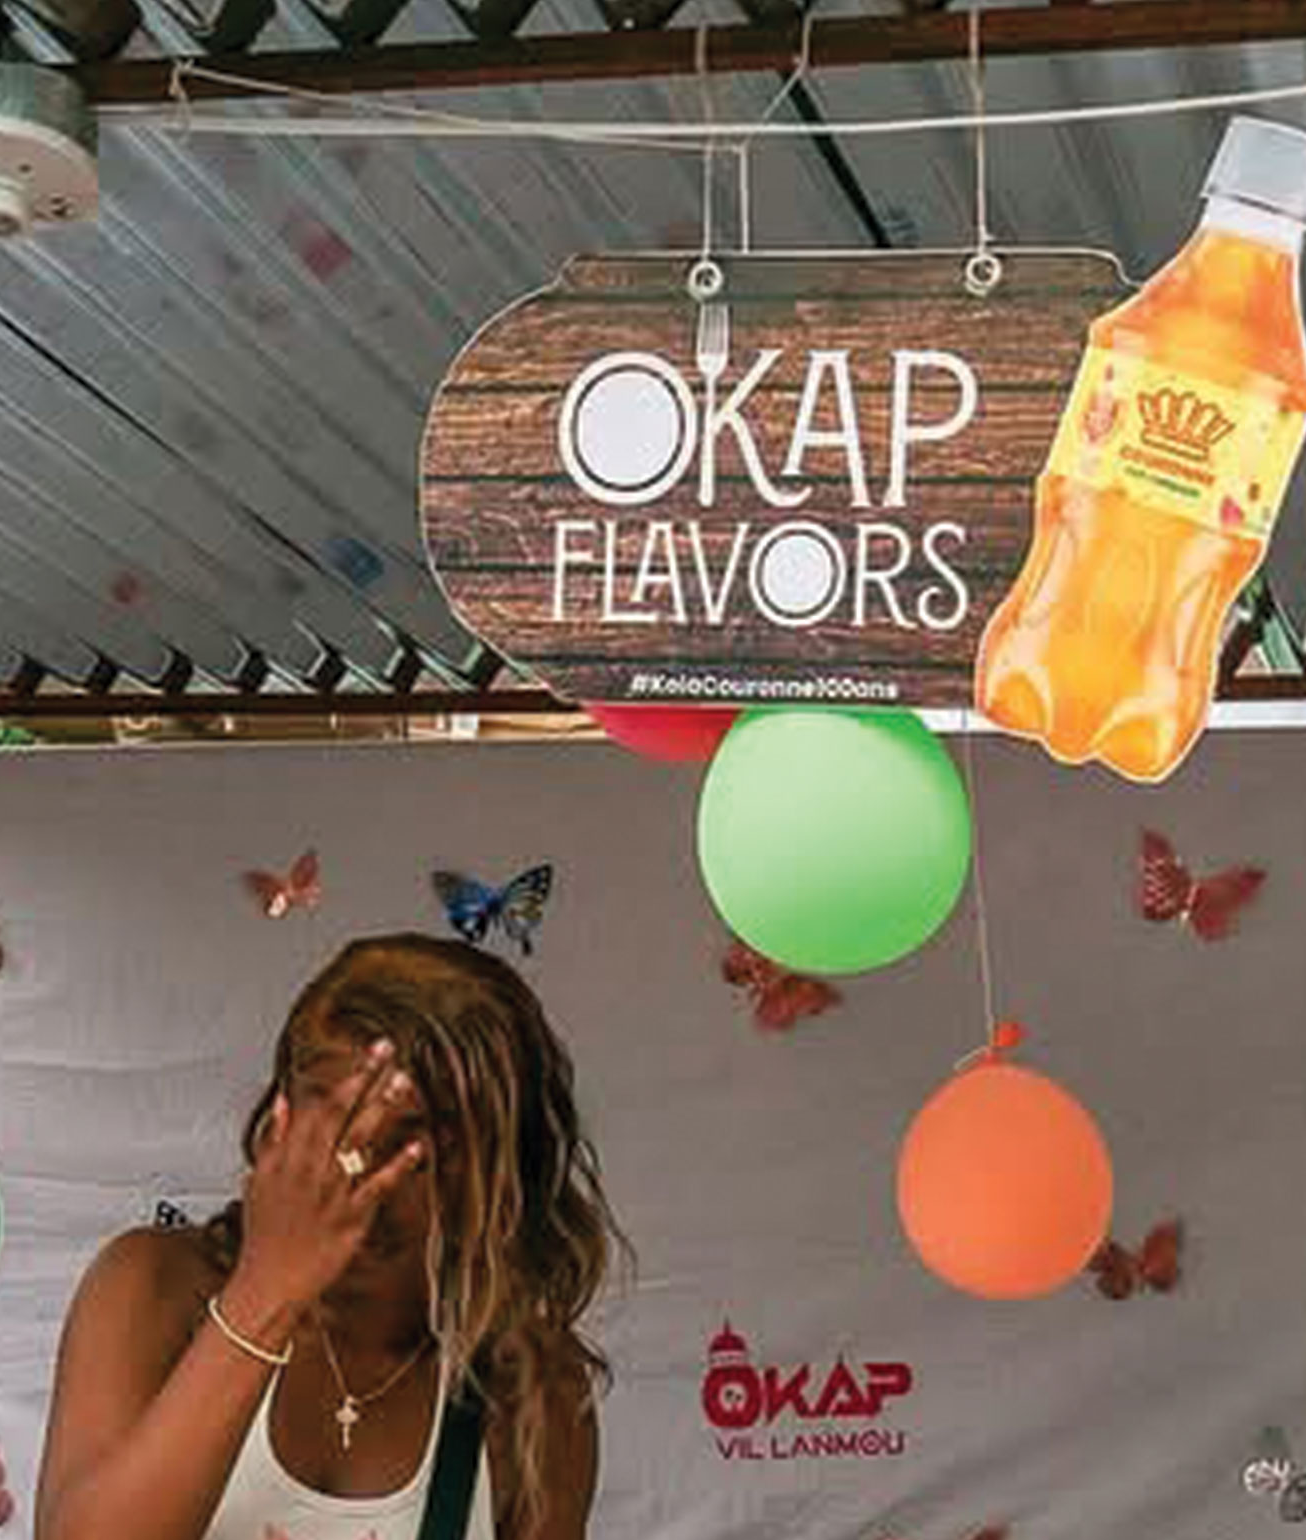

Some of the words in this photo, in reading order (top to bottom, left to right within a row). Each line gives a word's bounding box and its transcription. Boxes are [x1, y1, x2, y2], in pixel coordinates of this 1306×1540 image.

[559, 346, 976, 508] OKAP
[552, 519, 968, 628] FLAVORS
[701, 1361, 913, 1429] OKAP
[717, 1437, 760, 1460] VIL
[771, 1430, 905, 1459] LANMOU
